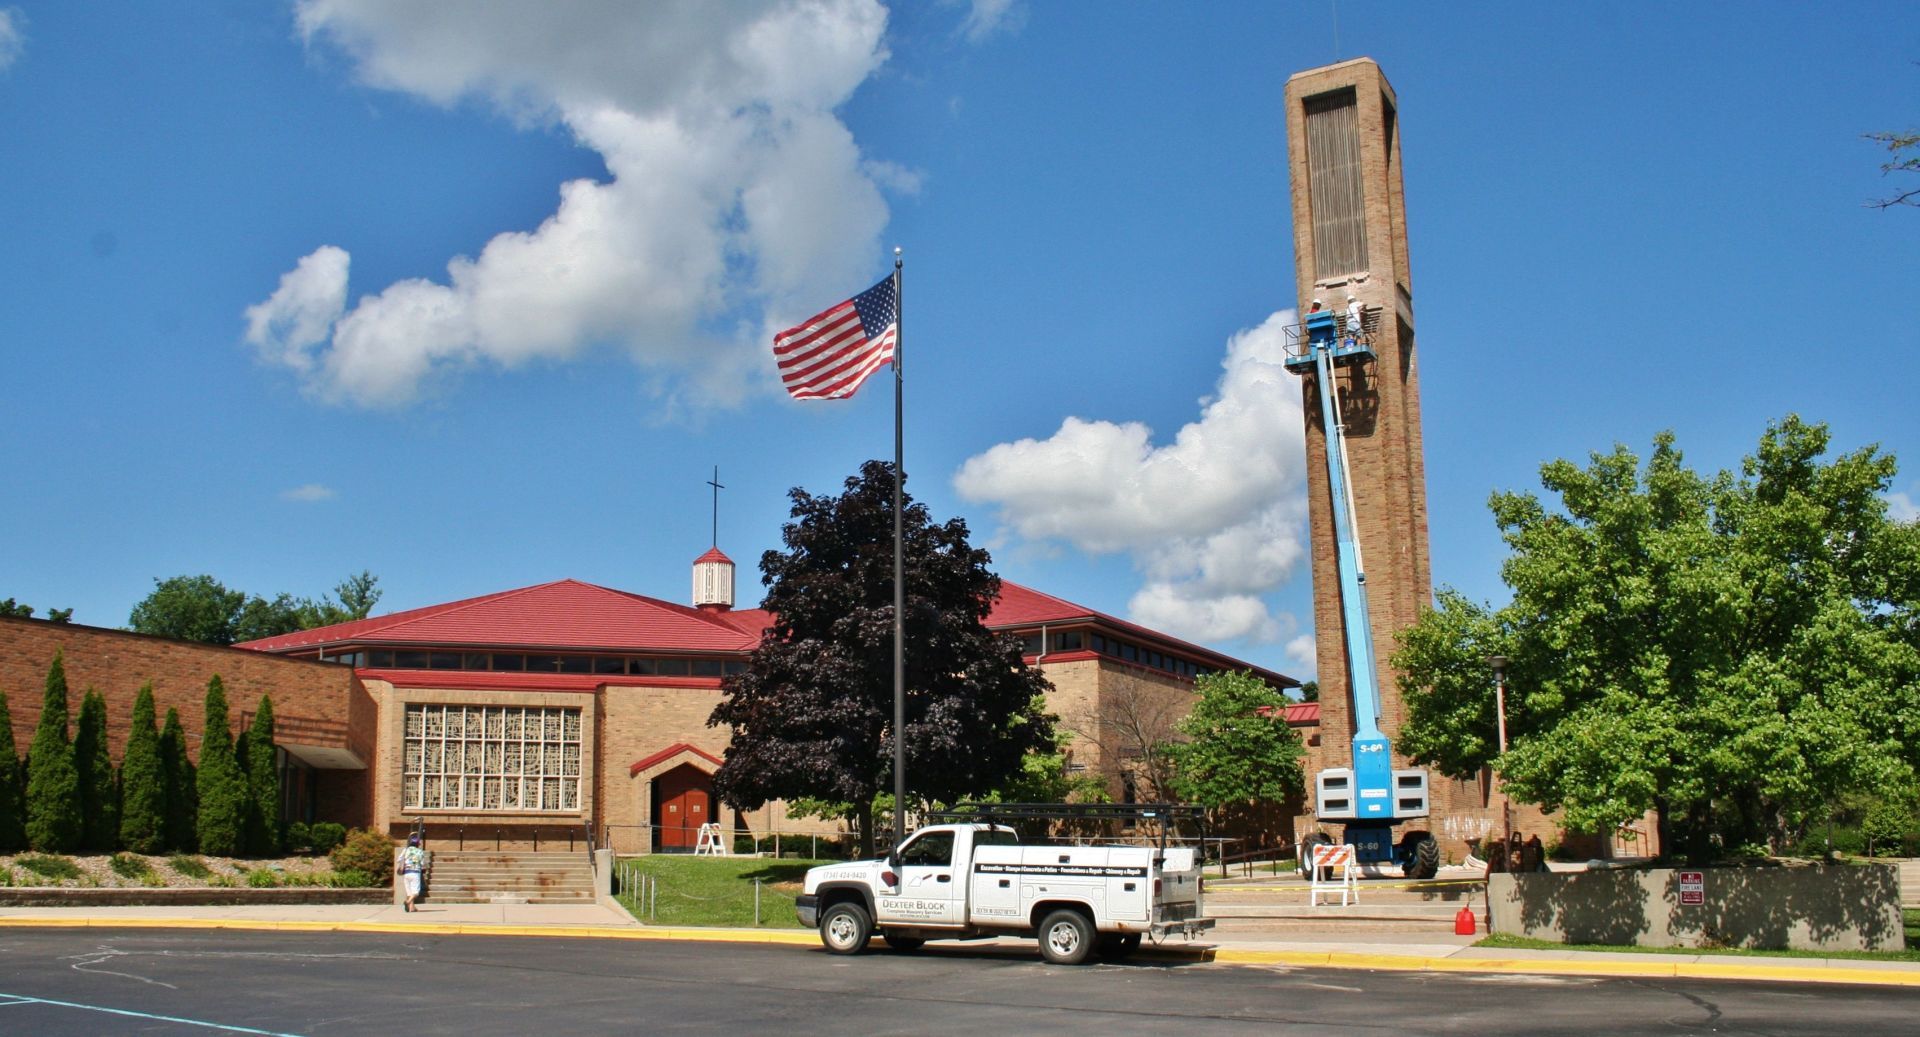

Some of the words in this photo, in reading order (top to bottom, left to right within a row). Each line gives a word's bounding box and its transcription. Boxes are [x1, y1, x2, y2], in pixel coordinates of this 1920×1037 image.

[1360, 744, 1382, 752] S-60
[1358, 842, 1379, 850] S-60
[882, 899, 915, 909] DEXTER
[916, 901, 945, 910] BLOCK
